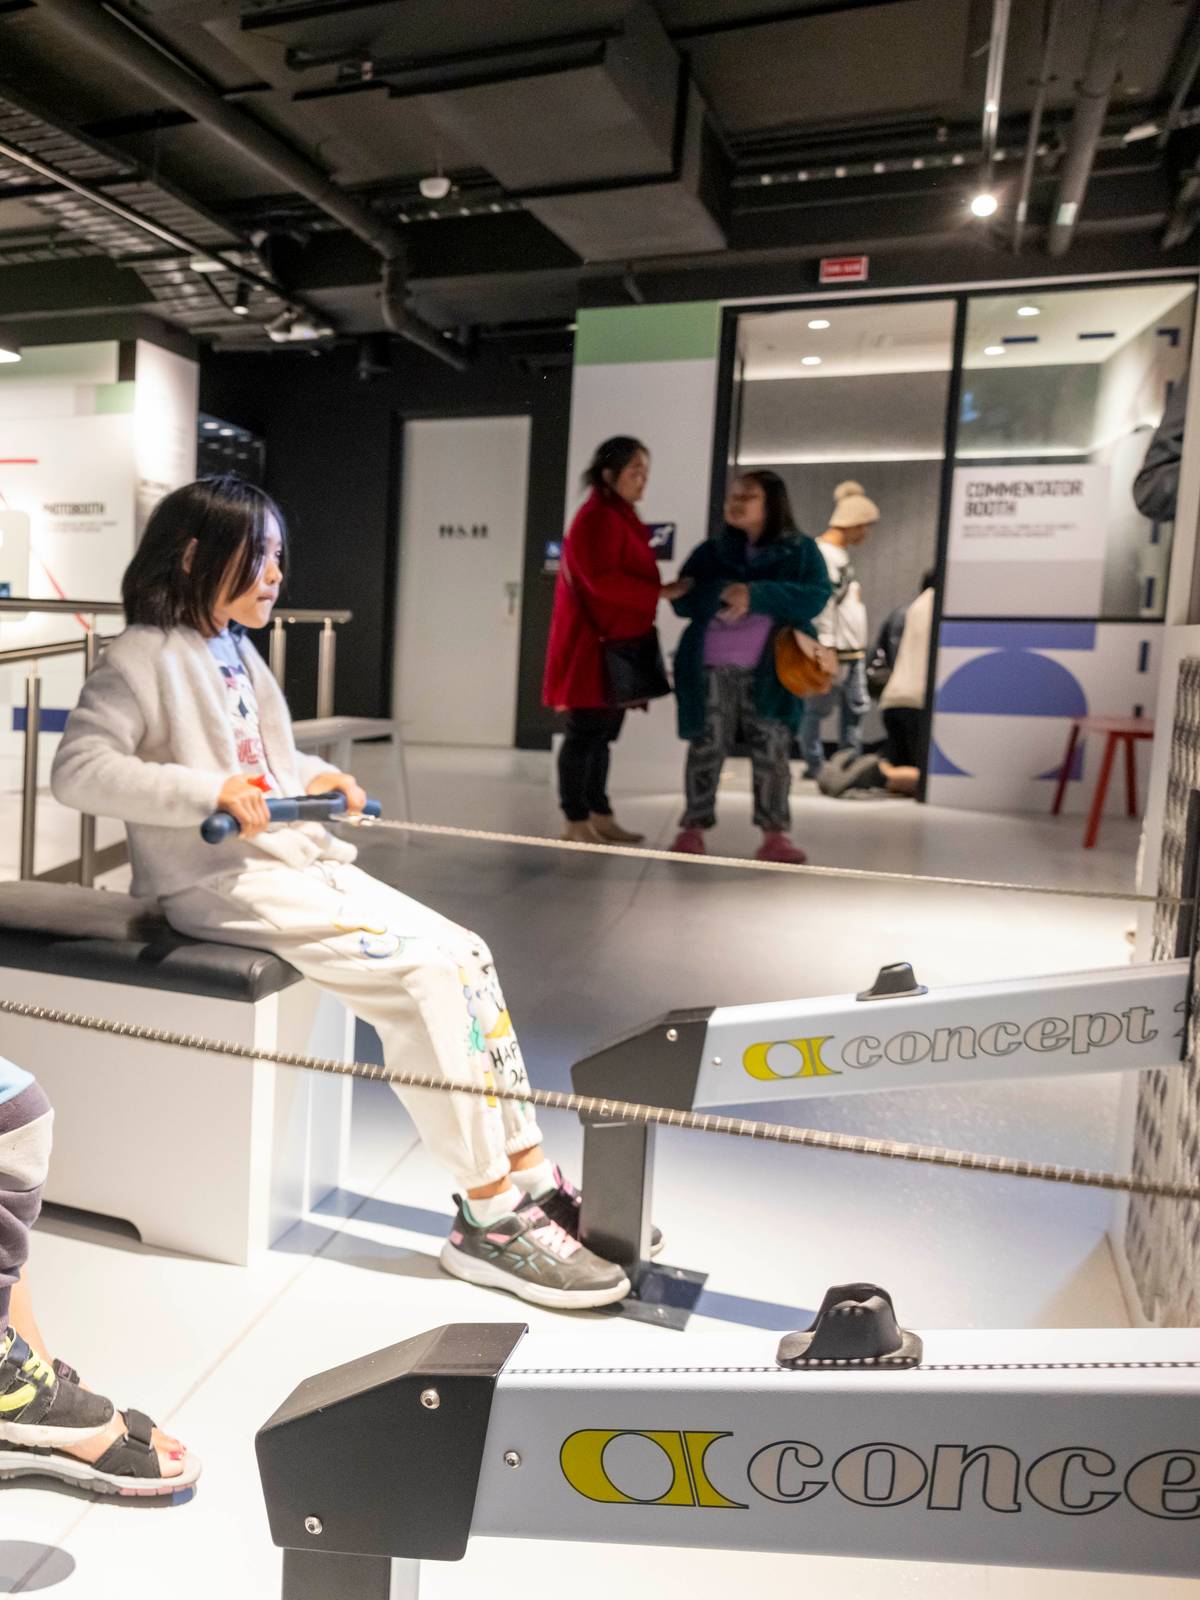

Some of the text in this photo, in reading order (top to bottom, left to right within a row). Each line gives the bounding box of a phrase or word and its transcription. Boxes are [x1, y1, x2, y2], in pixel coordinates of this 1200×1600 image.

[963, 500, 1017, 517] BOOTH
[965, 479, 1084, 498] COMMENTATOR
[841, 1006, 1159, 1070] concept
[747, 1440, 1200, 1521] conce
